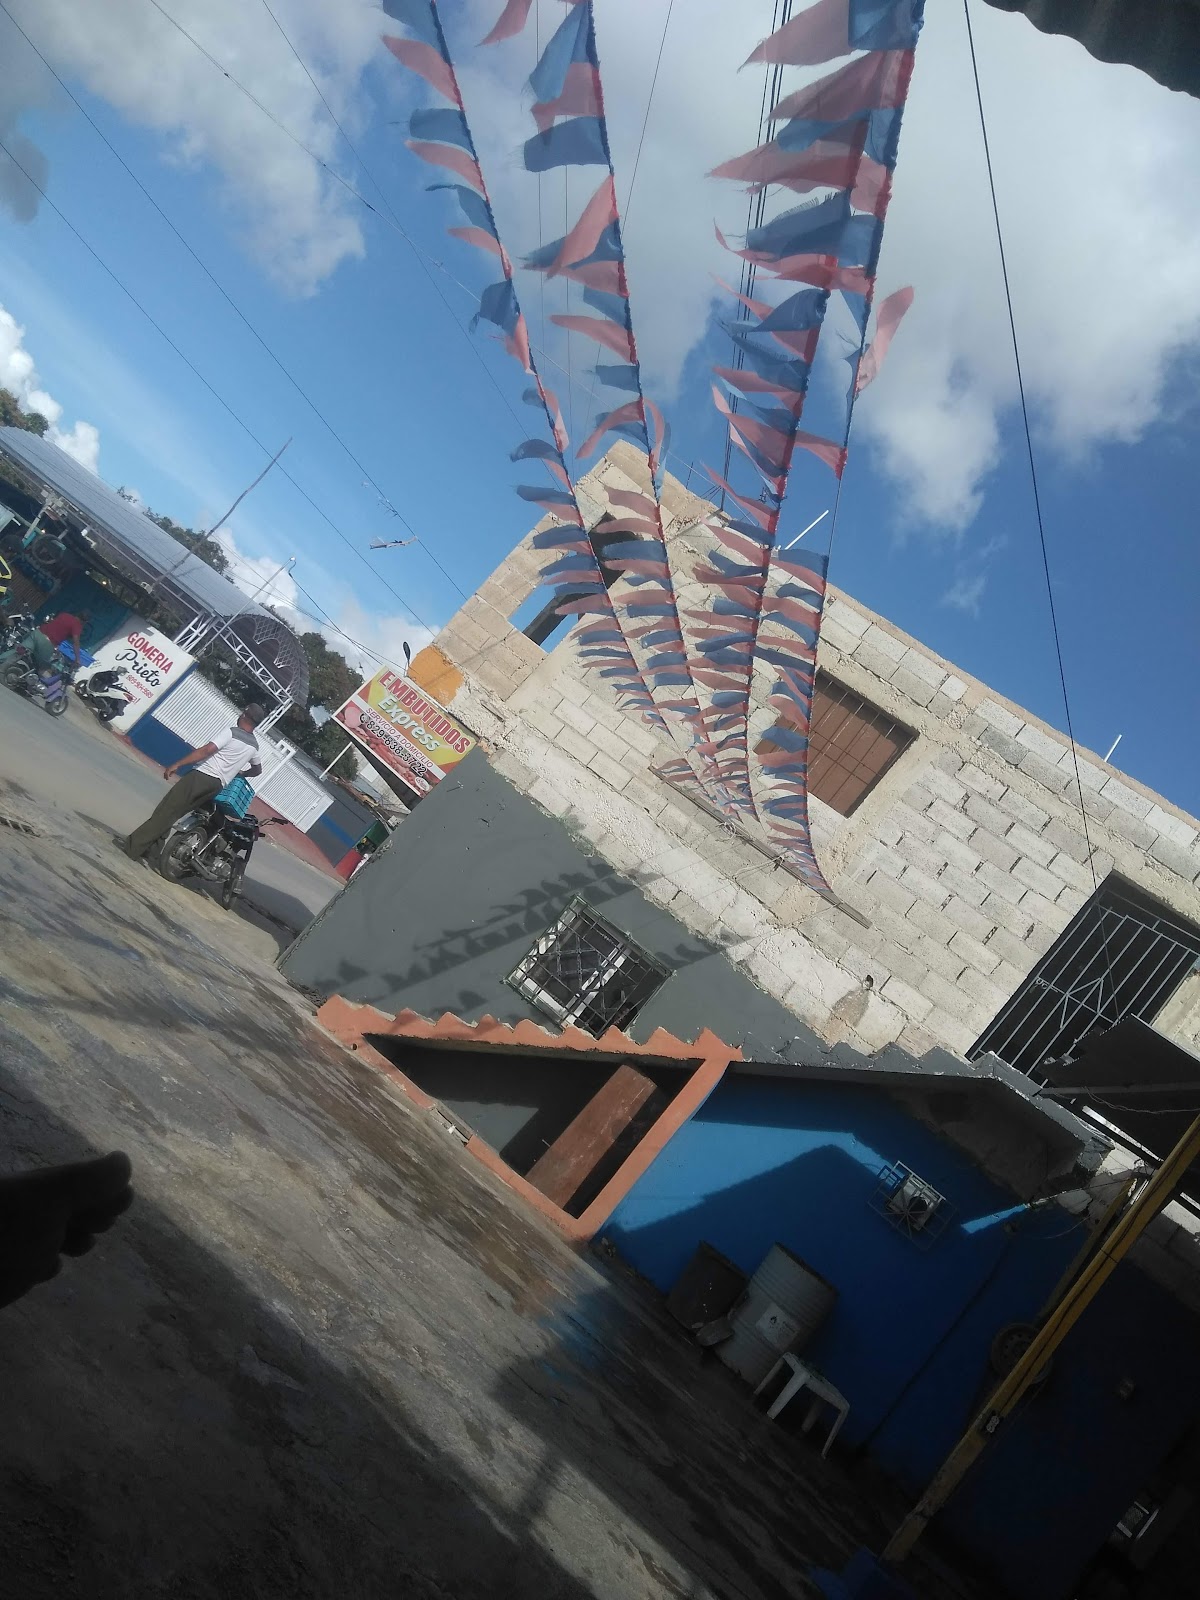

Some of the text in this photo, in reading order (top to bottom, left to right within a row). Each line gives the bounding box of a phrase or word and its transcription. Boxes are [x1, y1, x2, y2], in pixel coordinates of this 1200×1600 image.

[115, 649, 160, 687] Prieto
[127, 631, 173, 674] GOMERIA
[366, 707, 397, 736] SERVICIO
[400, 738, 434, 768] DOMICILIO
[378, 696, 440, 751] Express
[379, 670, 471, 754] EMBUTIDOS
[366, 720, 427, 777] 829-838-3722
